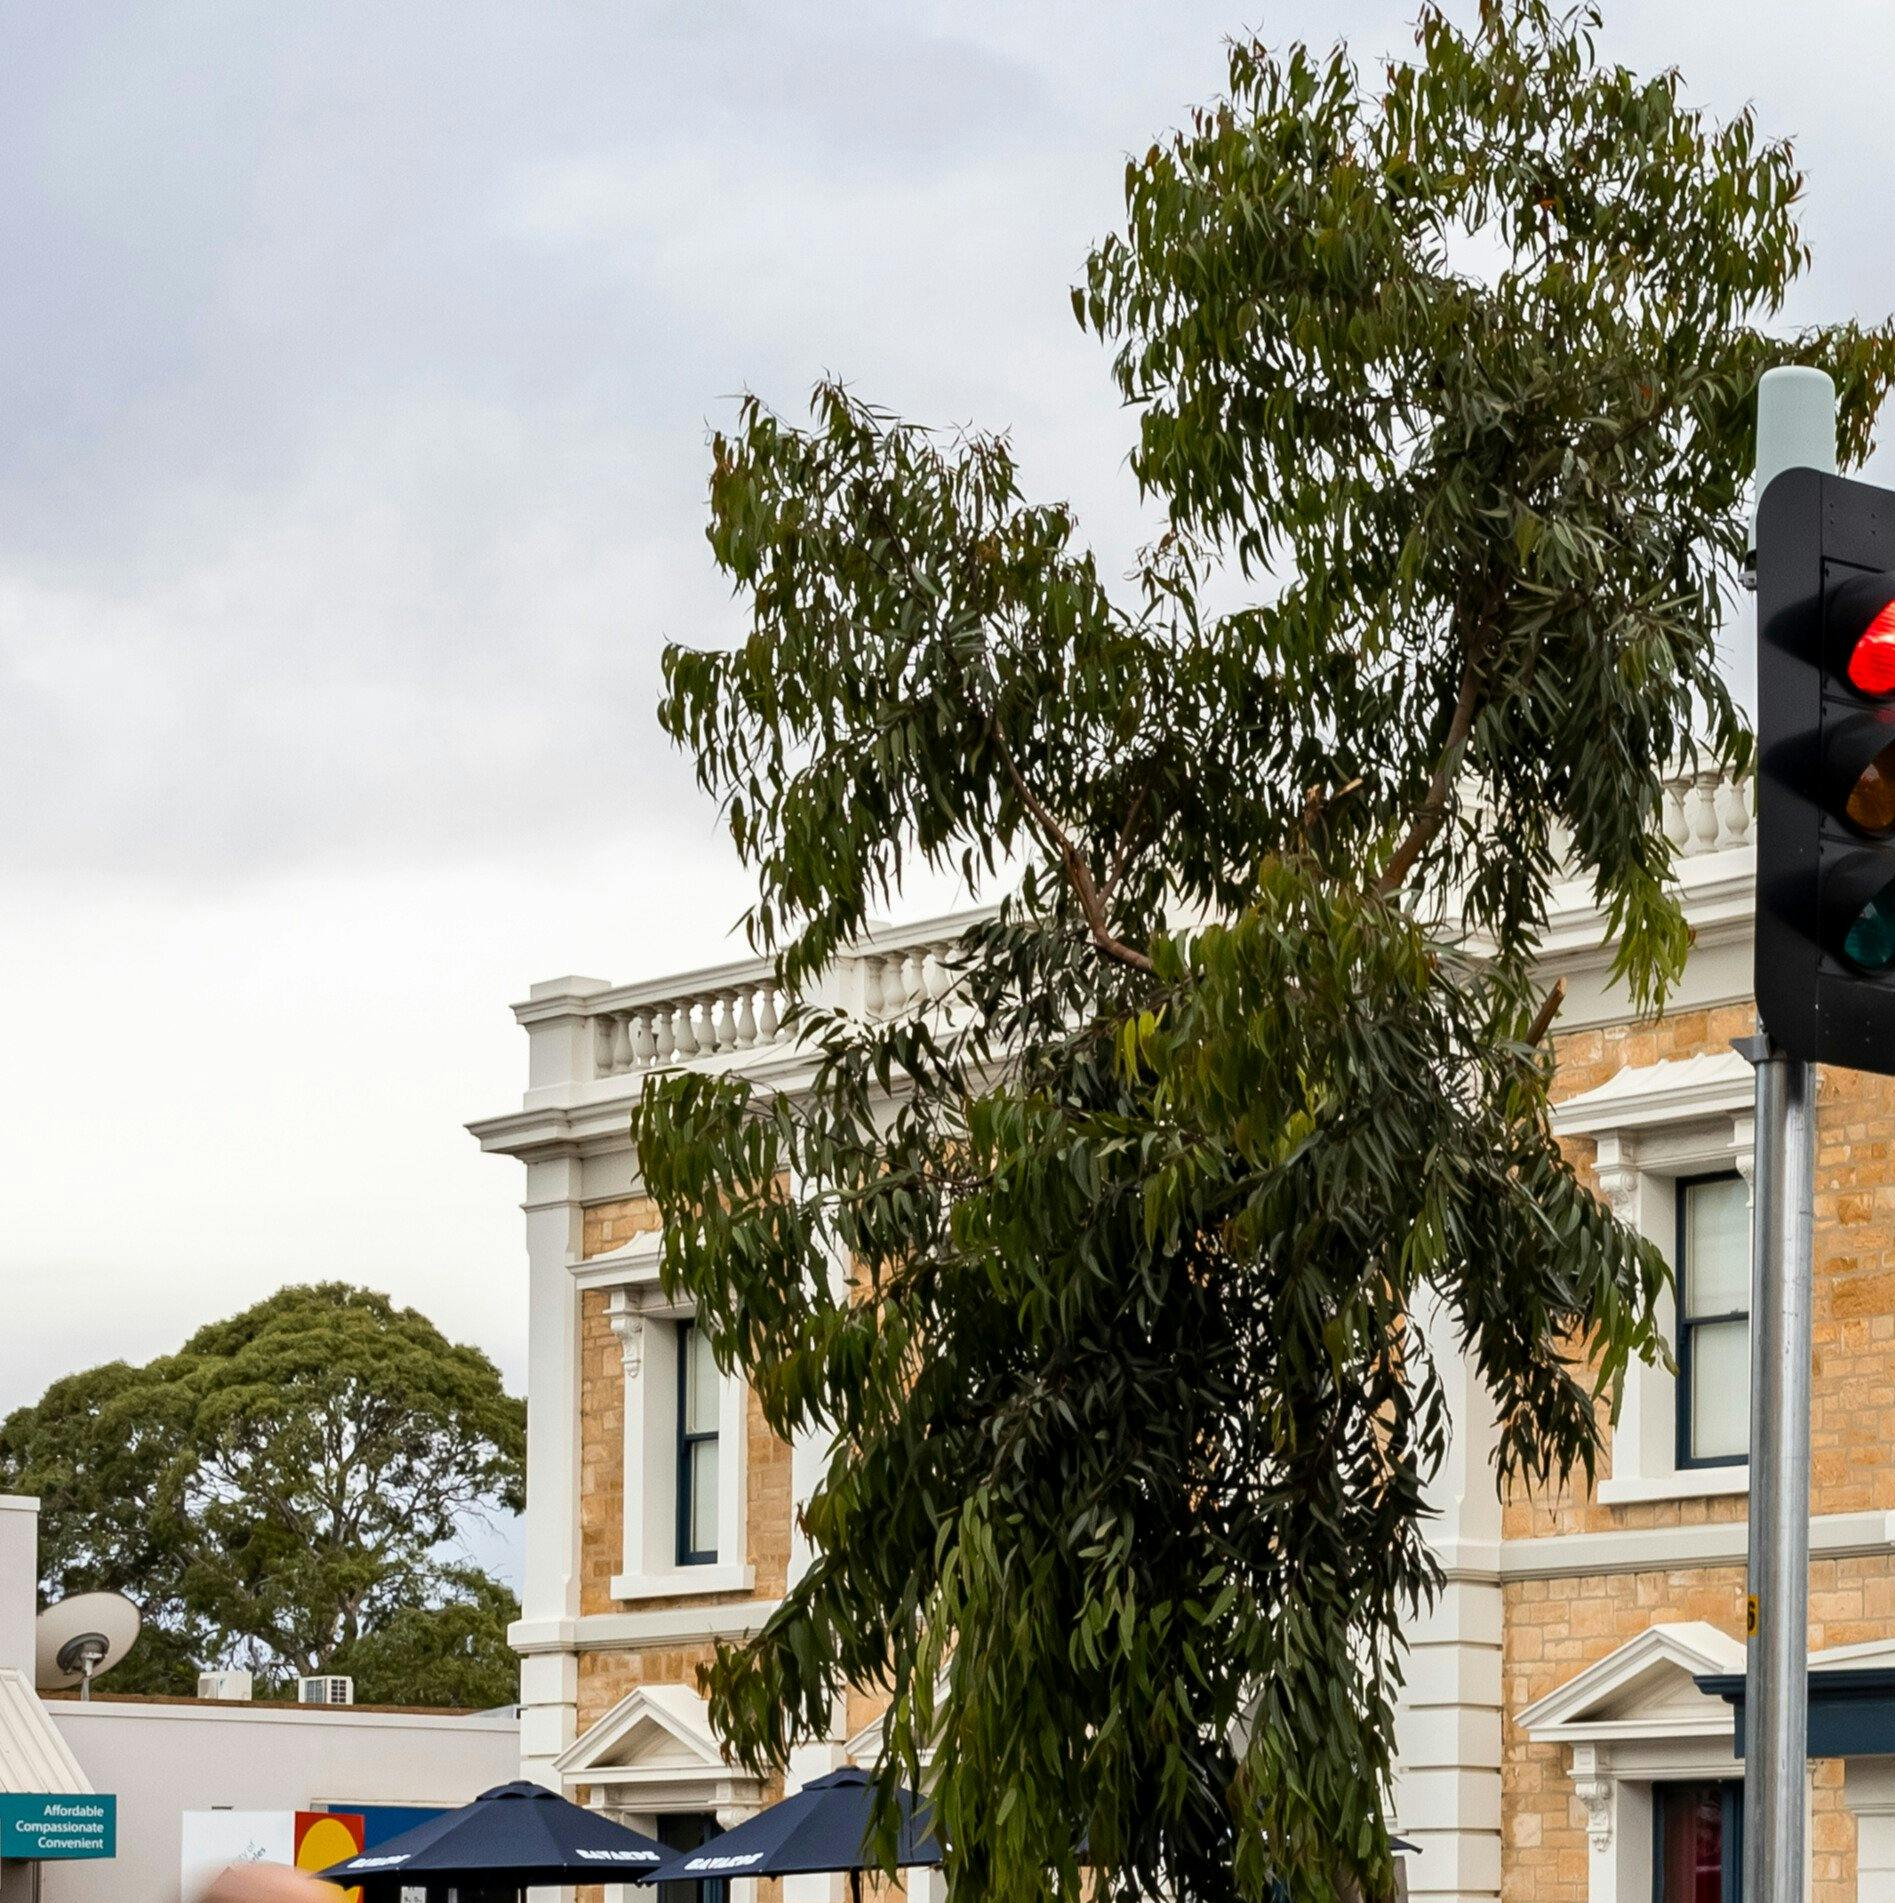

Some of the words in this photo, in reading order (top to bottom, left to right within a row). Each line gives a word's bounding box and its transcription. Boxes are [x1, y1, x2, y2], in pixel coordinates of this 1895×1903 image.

[44, 1804, 104, 1817] Affordable
[15, 1820, 104, 1834] Compassionate
[38, 1836, 104, 1849] Convenient
